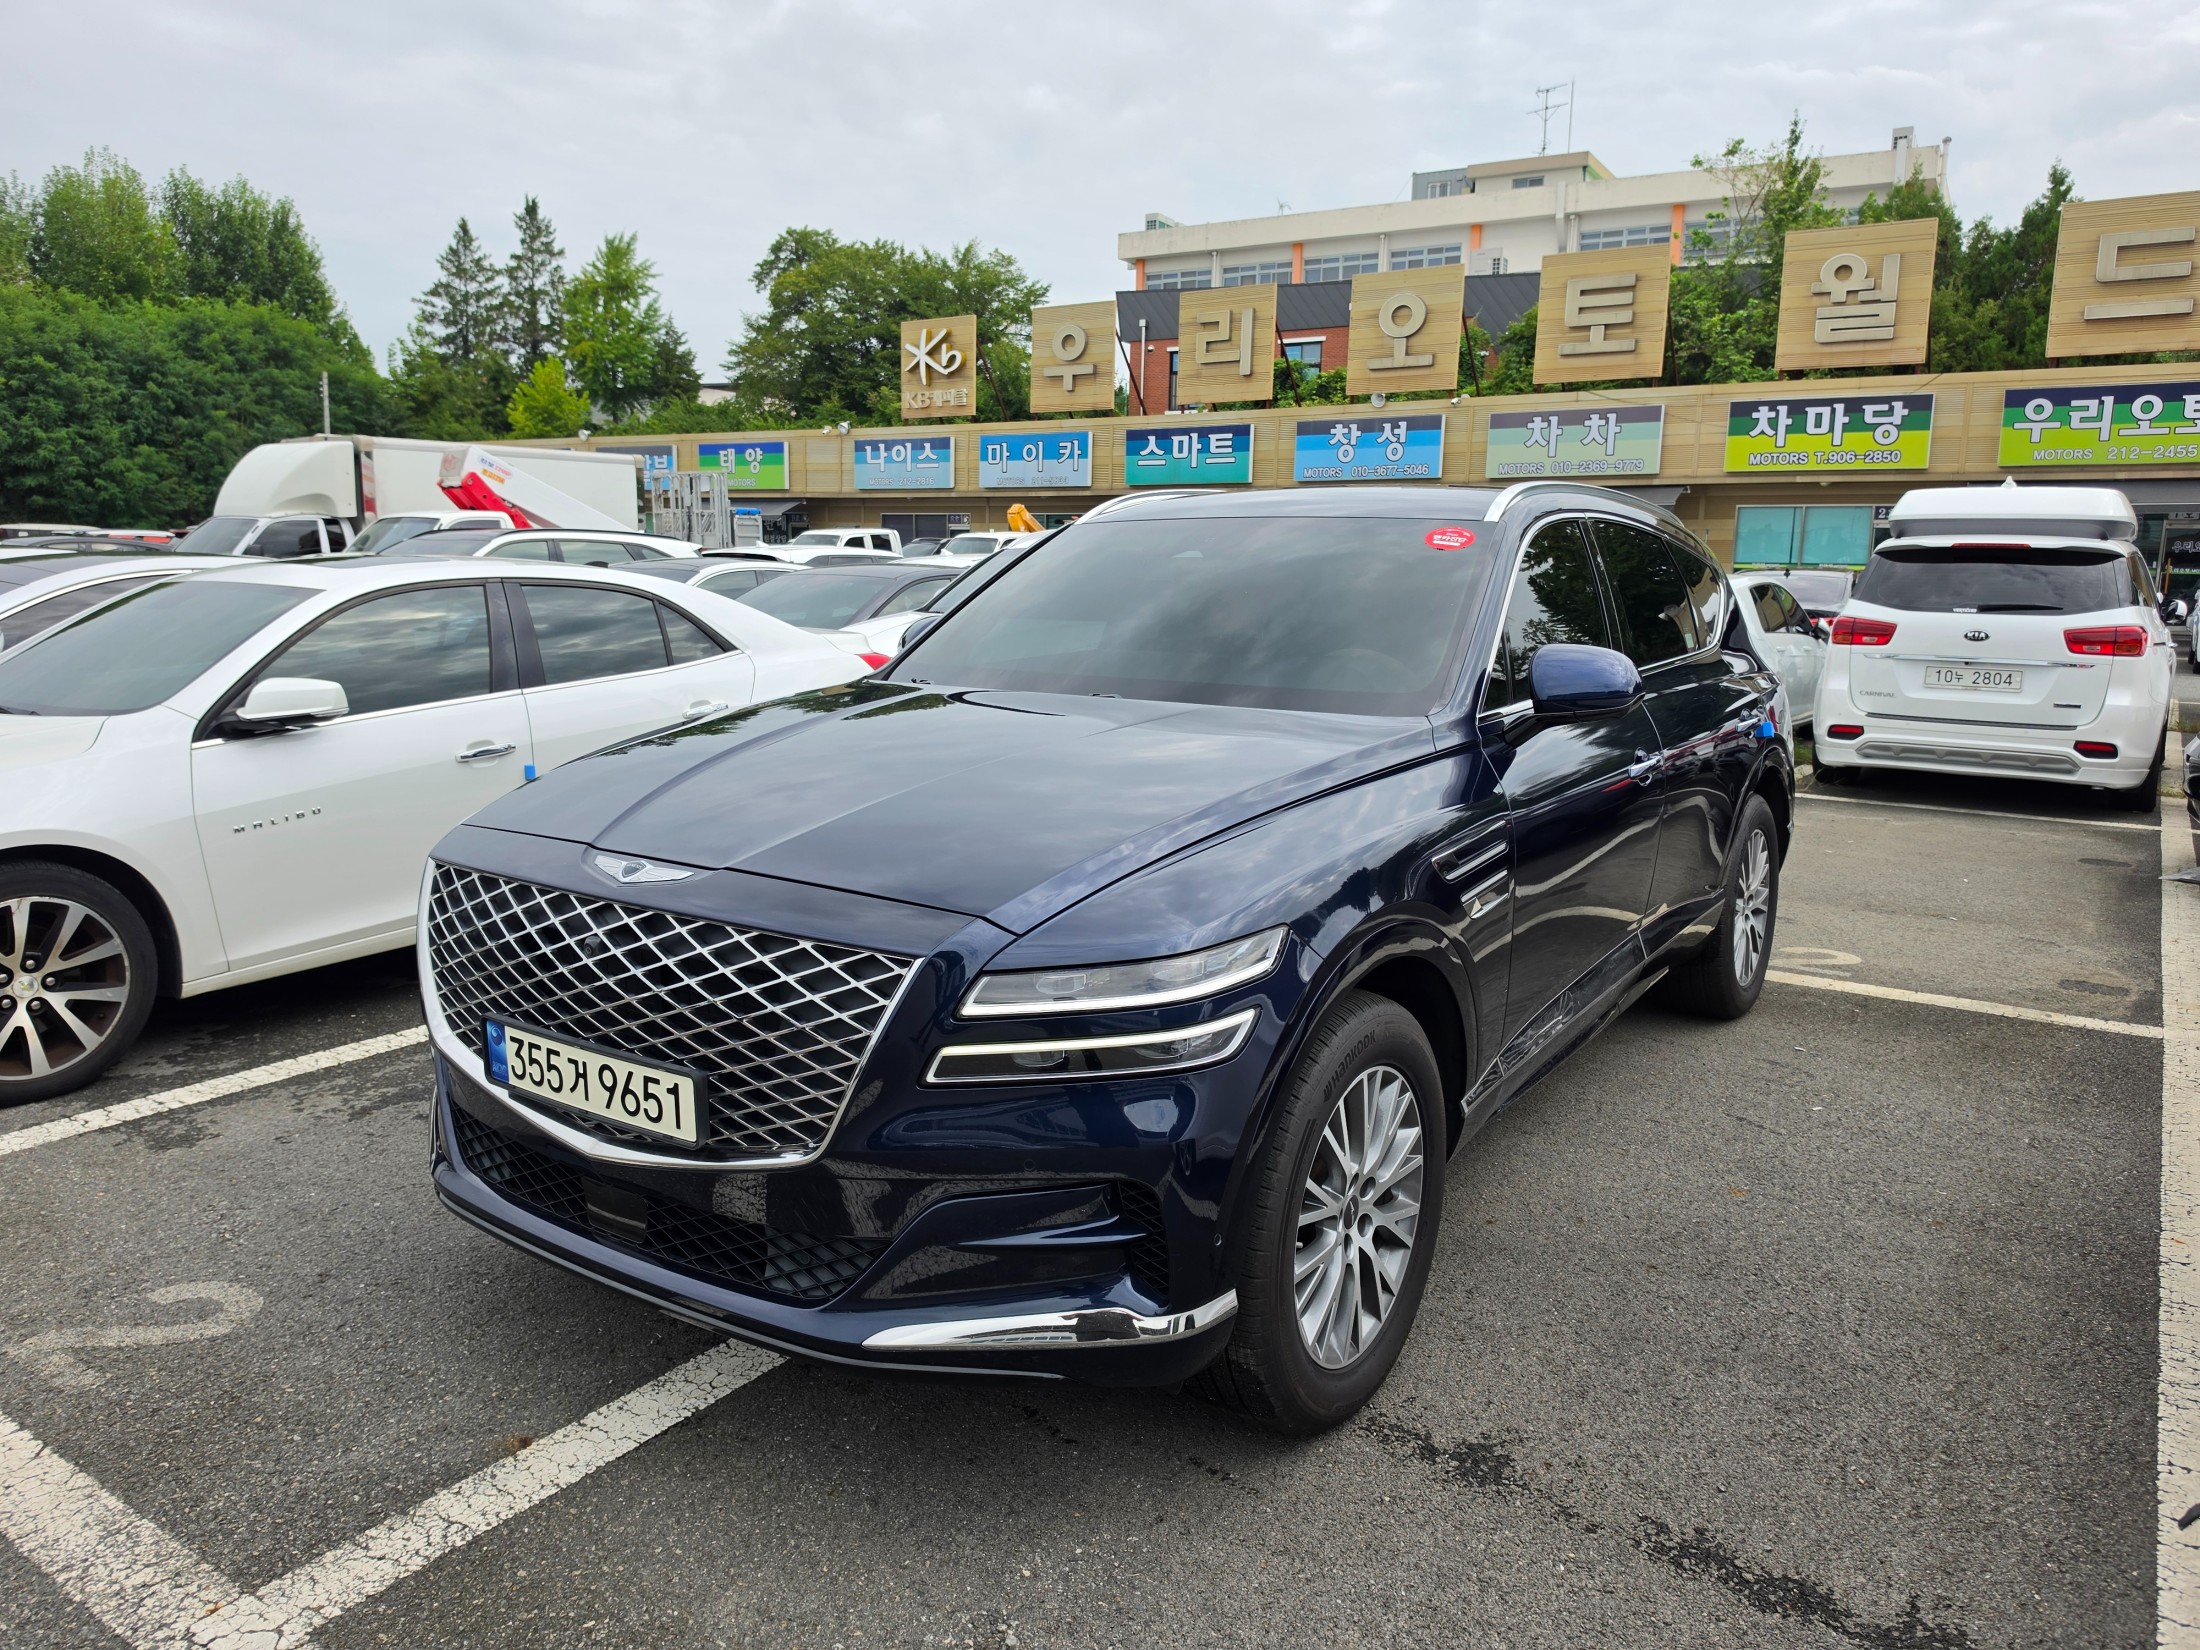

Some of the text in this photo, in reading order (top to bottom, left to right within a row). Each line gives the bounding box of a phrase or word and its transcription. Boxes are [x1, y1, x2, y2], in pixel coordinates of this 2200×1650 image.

[1523, 412, 1622, 458] 차차
[1748, 401, 1909, 448] 차마당
[1137, 432, 1236, 468] 스마트
[1328, 421, 1407, 463] 창성
[2033, 444, 2198, 461] MOTORS 212-2455
[719, 447, 763, 474] 태양
[865, 442, 939, 472] 나이스
[986, 439, 1082, 473] 마이카
[1498, 458, 1644, 475] MOTORS 010-2369-9779
[1748, 450, 1901, 465] MOTORS T.906-2850
[728, 478, 756, 487] MOTORS
[1303, 463, 1430, 478] MOTORS 010-3677-5046
[1966, 630, 1987, 641] KIA
[1972, 671, 2013, 686] 2804
[233, 806, 321, 834] MALIBU
[598, 1063, 682, 1130] 9651
